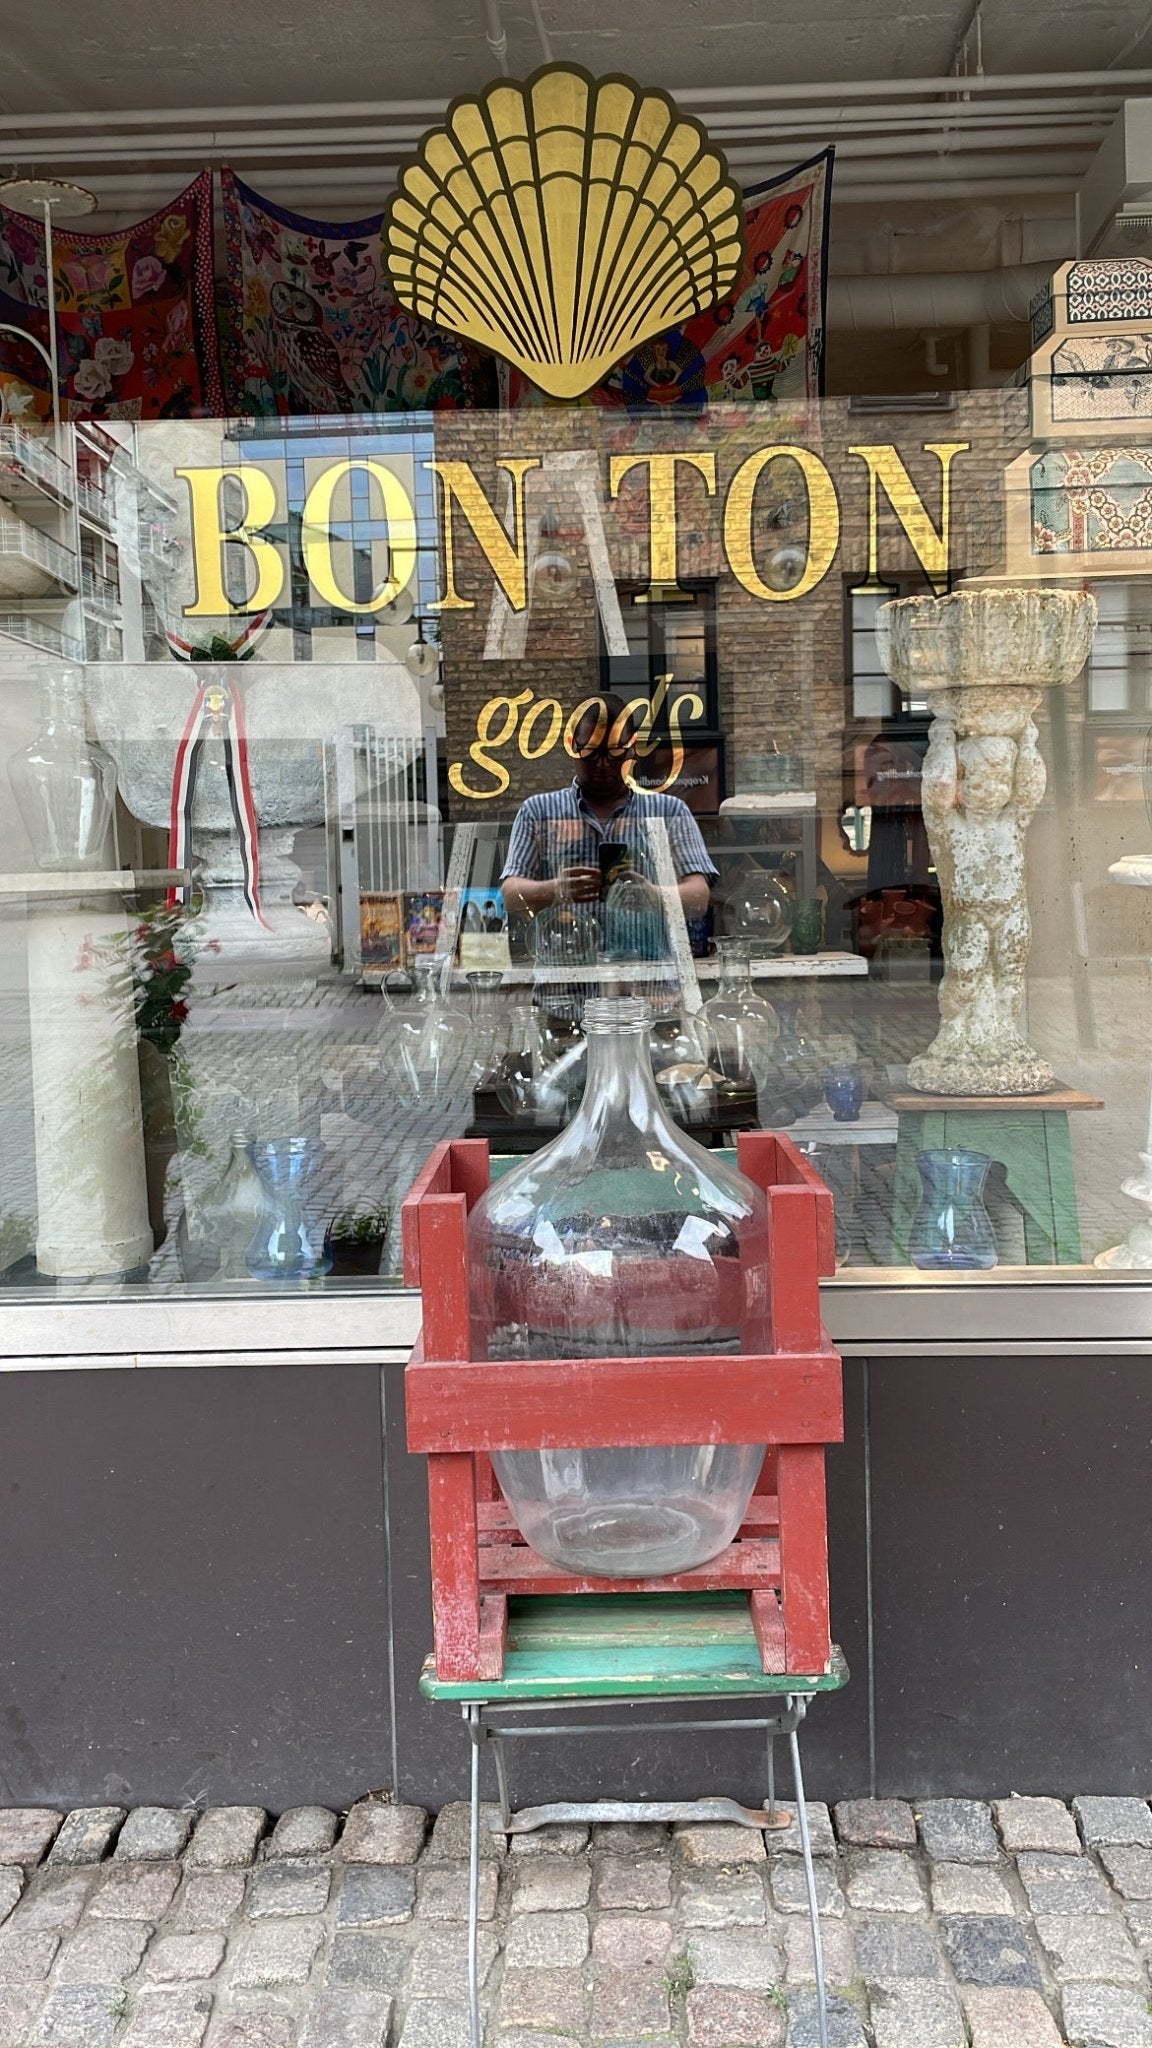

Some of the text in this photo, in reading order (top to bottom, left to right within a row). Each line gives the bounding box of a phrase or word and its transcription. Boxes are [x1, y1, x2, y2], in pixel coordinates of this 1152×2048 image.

[175, 442, 970, 616] BON TON
[448, 673, 704, 799] goods
